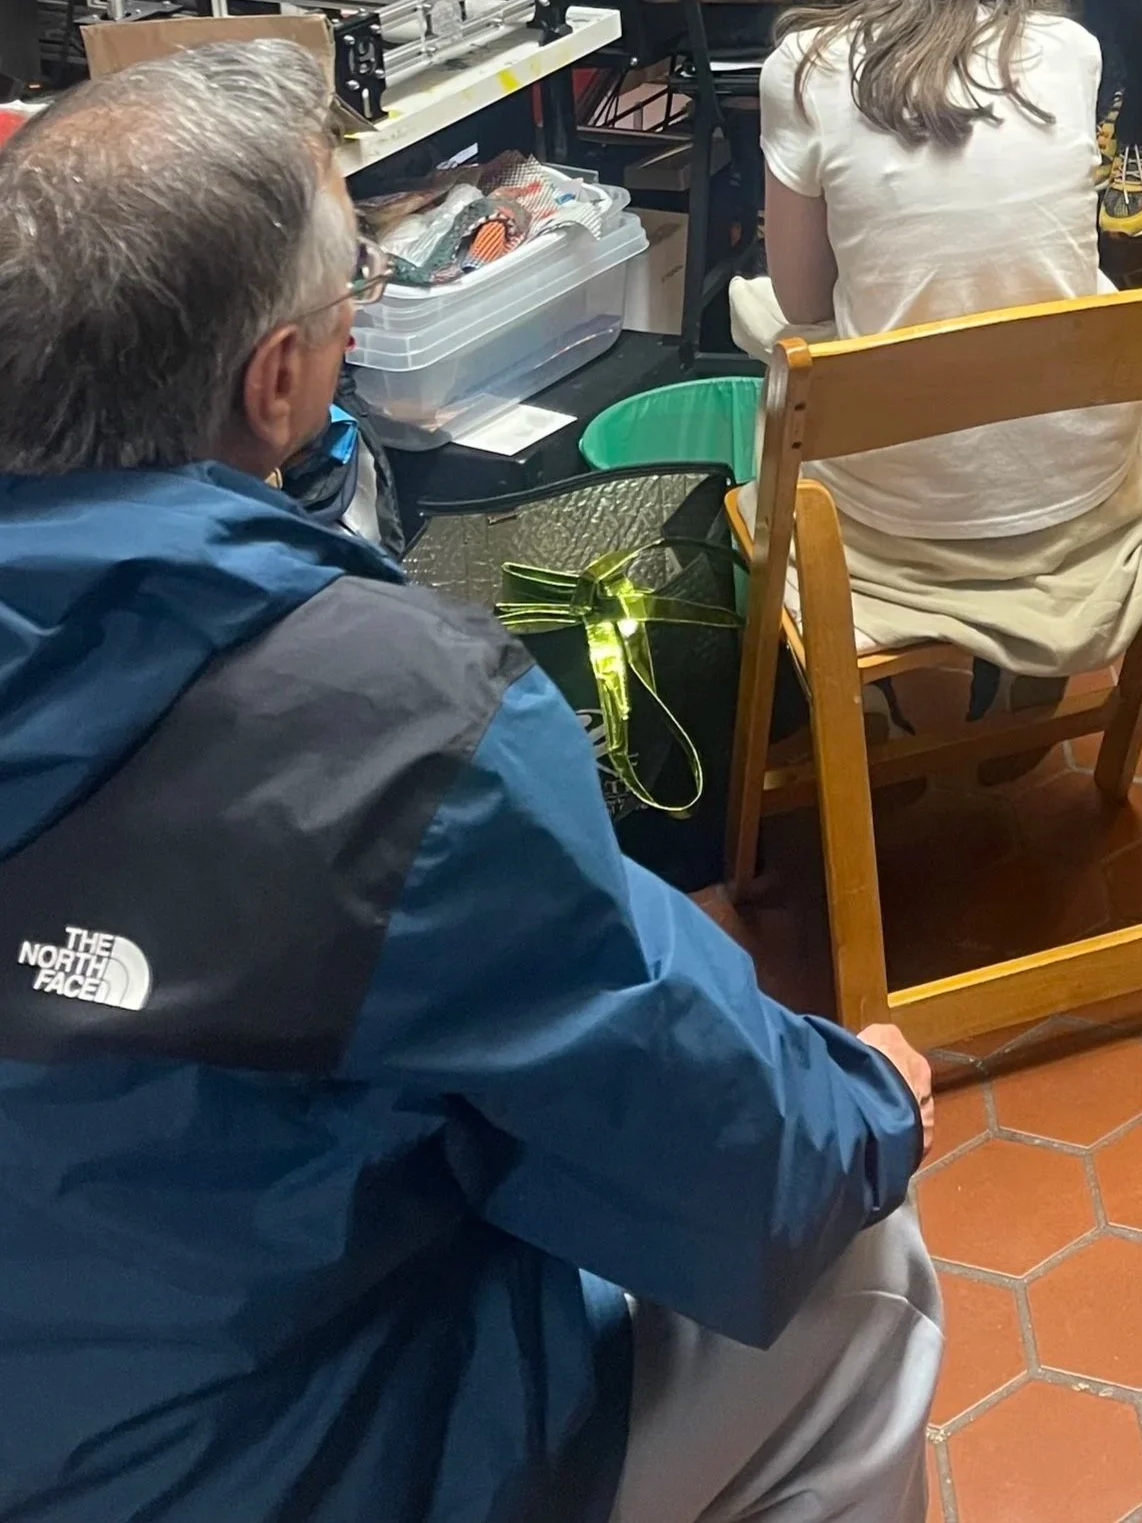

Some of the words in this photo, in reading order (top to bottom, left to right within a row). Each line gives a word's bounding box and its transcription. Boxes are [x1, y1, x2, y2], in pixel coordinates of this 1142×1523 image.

[65, 926, 114, 957] THE
[18, 941, 109, 978] NORTH
[33, 968, 101, 1001] FACE
